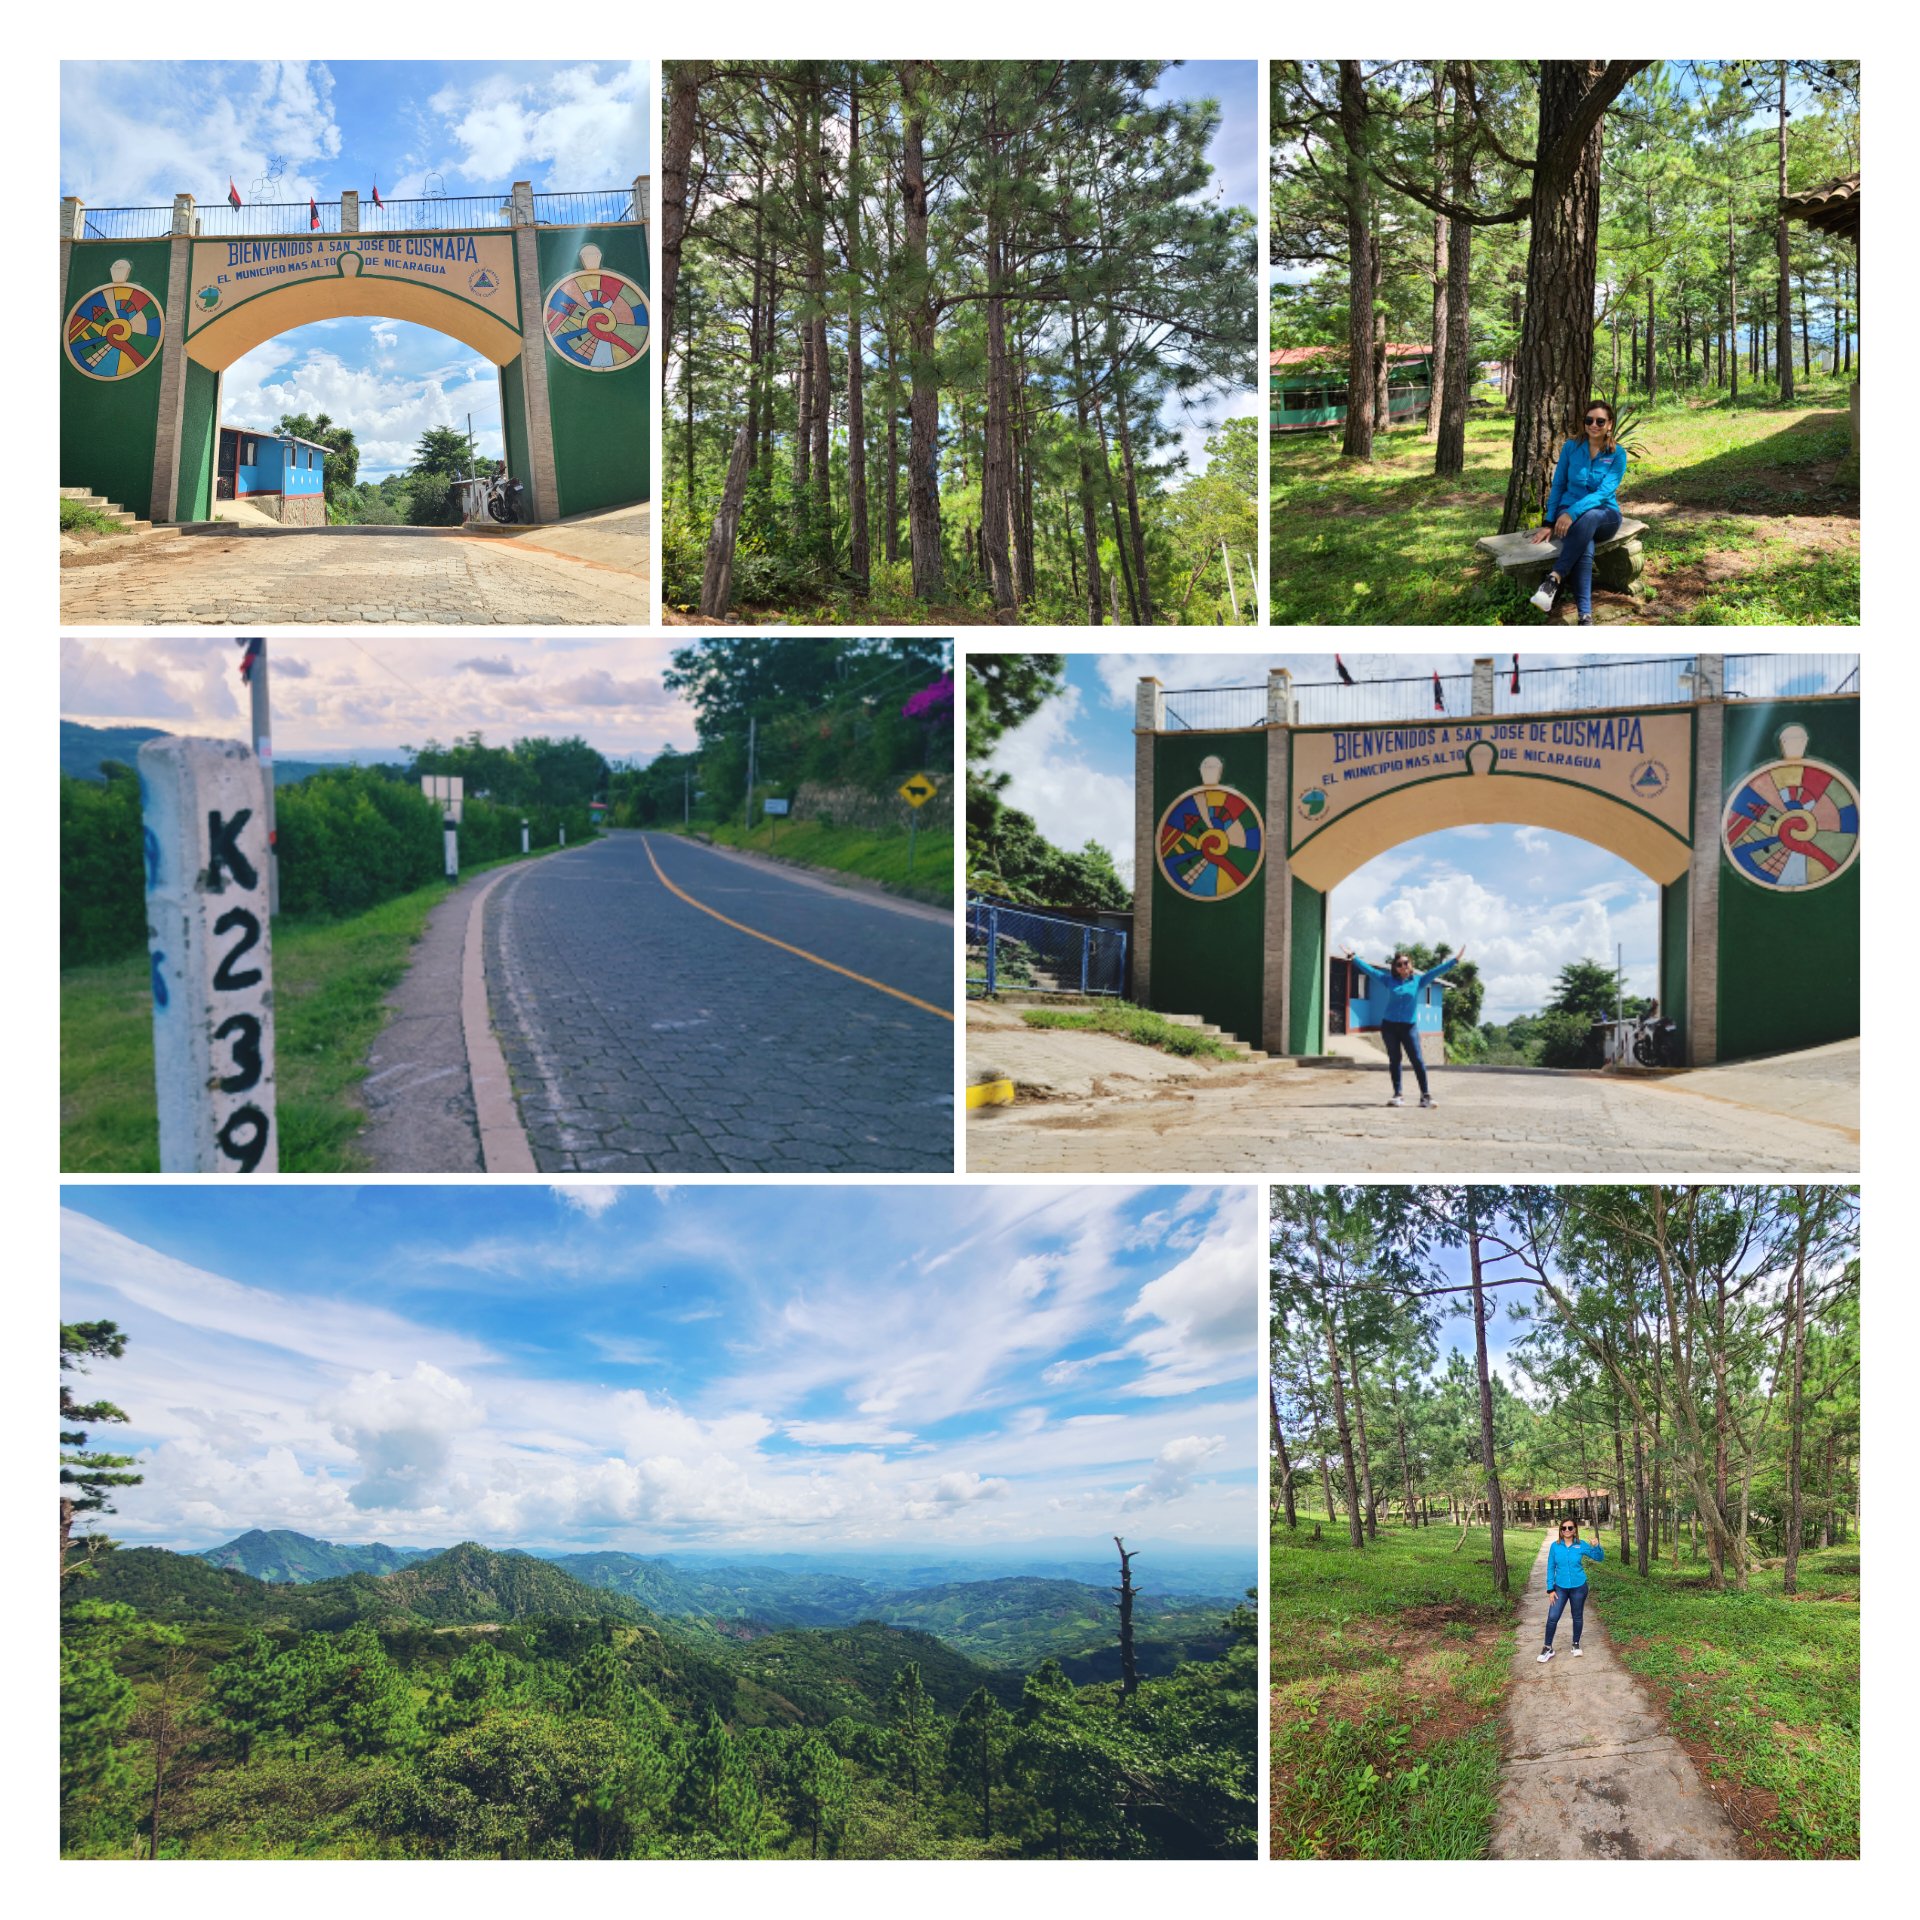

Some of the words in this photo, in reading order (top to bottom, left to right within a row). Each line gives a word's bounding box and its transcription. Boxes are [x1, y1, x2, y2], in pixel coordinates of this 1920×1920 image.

[227, 242, 312, 266] BIENVENIDOS
[318, 242, 324, 252] A
[329, 241, 351, 251] SAN
[357, 240, 384, 250] JOSE
[388, 240, 402, 253] DE
[406, 237, 478, 263] CUSMAPA
[217, 275, 231, 284] EL
[235, 265, 286, 280] MUNICIPIO
[288, 261, 308, 272] MAS
[311, 257, 336, 269] ALTO
[365, 256, 379, 266] DE
[384, 259, 446, 274] NICARAGUA
[1333, 729, 1436, 763] BIENVENIDOS
[1441, 730, 1449, 742] A
[1456, 727, 1482, 741] SAN
[1490, 724, 1524, 740] JOSE
[1529, 723, 1546, 742] DE
[1552, 717, 1644, 753] CUSMAPA
[1322, 774, 1339, 785] EL
[1343, 761, 1403, 780] MUNICIPIO
[1405, 754, 1430, 769] MAS
[1433, 748, 1465, 764] ALTO
[1500, 747, 1517, 760] DE
[1523, 748, 1601, 769] NICARAGUA
